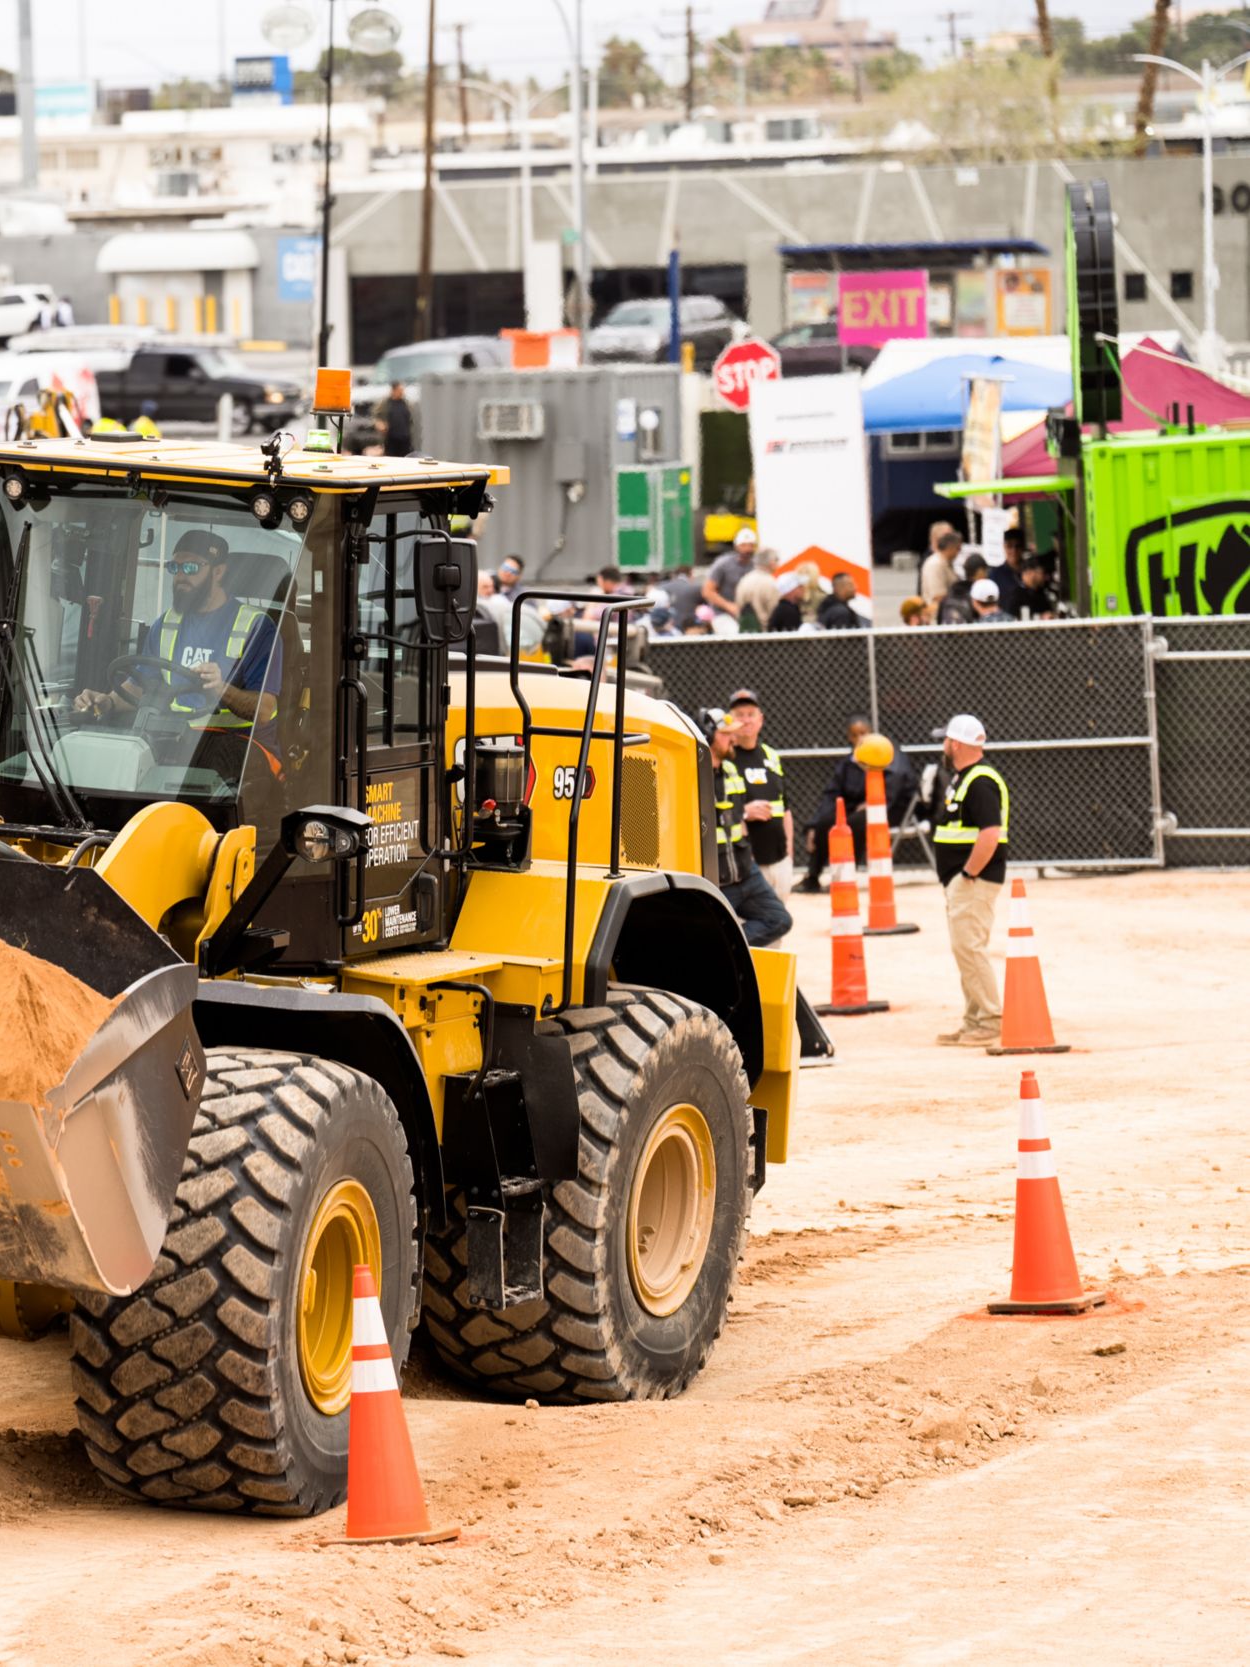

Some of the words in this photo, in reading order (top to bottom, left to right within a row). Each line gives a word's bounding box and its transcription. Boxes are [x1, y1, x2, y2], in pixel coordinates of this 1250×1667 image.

[841, 287, 923, 328] EXIT
[718, 356, 777, 394] STOP
[181, 645, 213, 668] CAT
[380, 820, 419, 844] EFFICIENT
